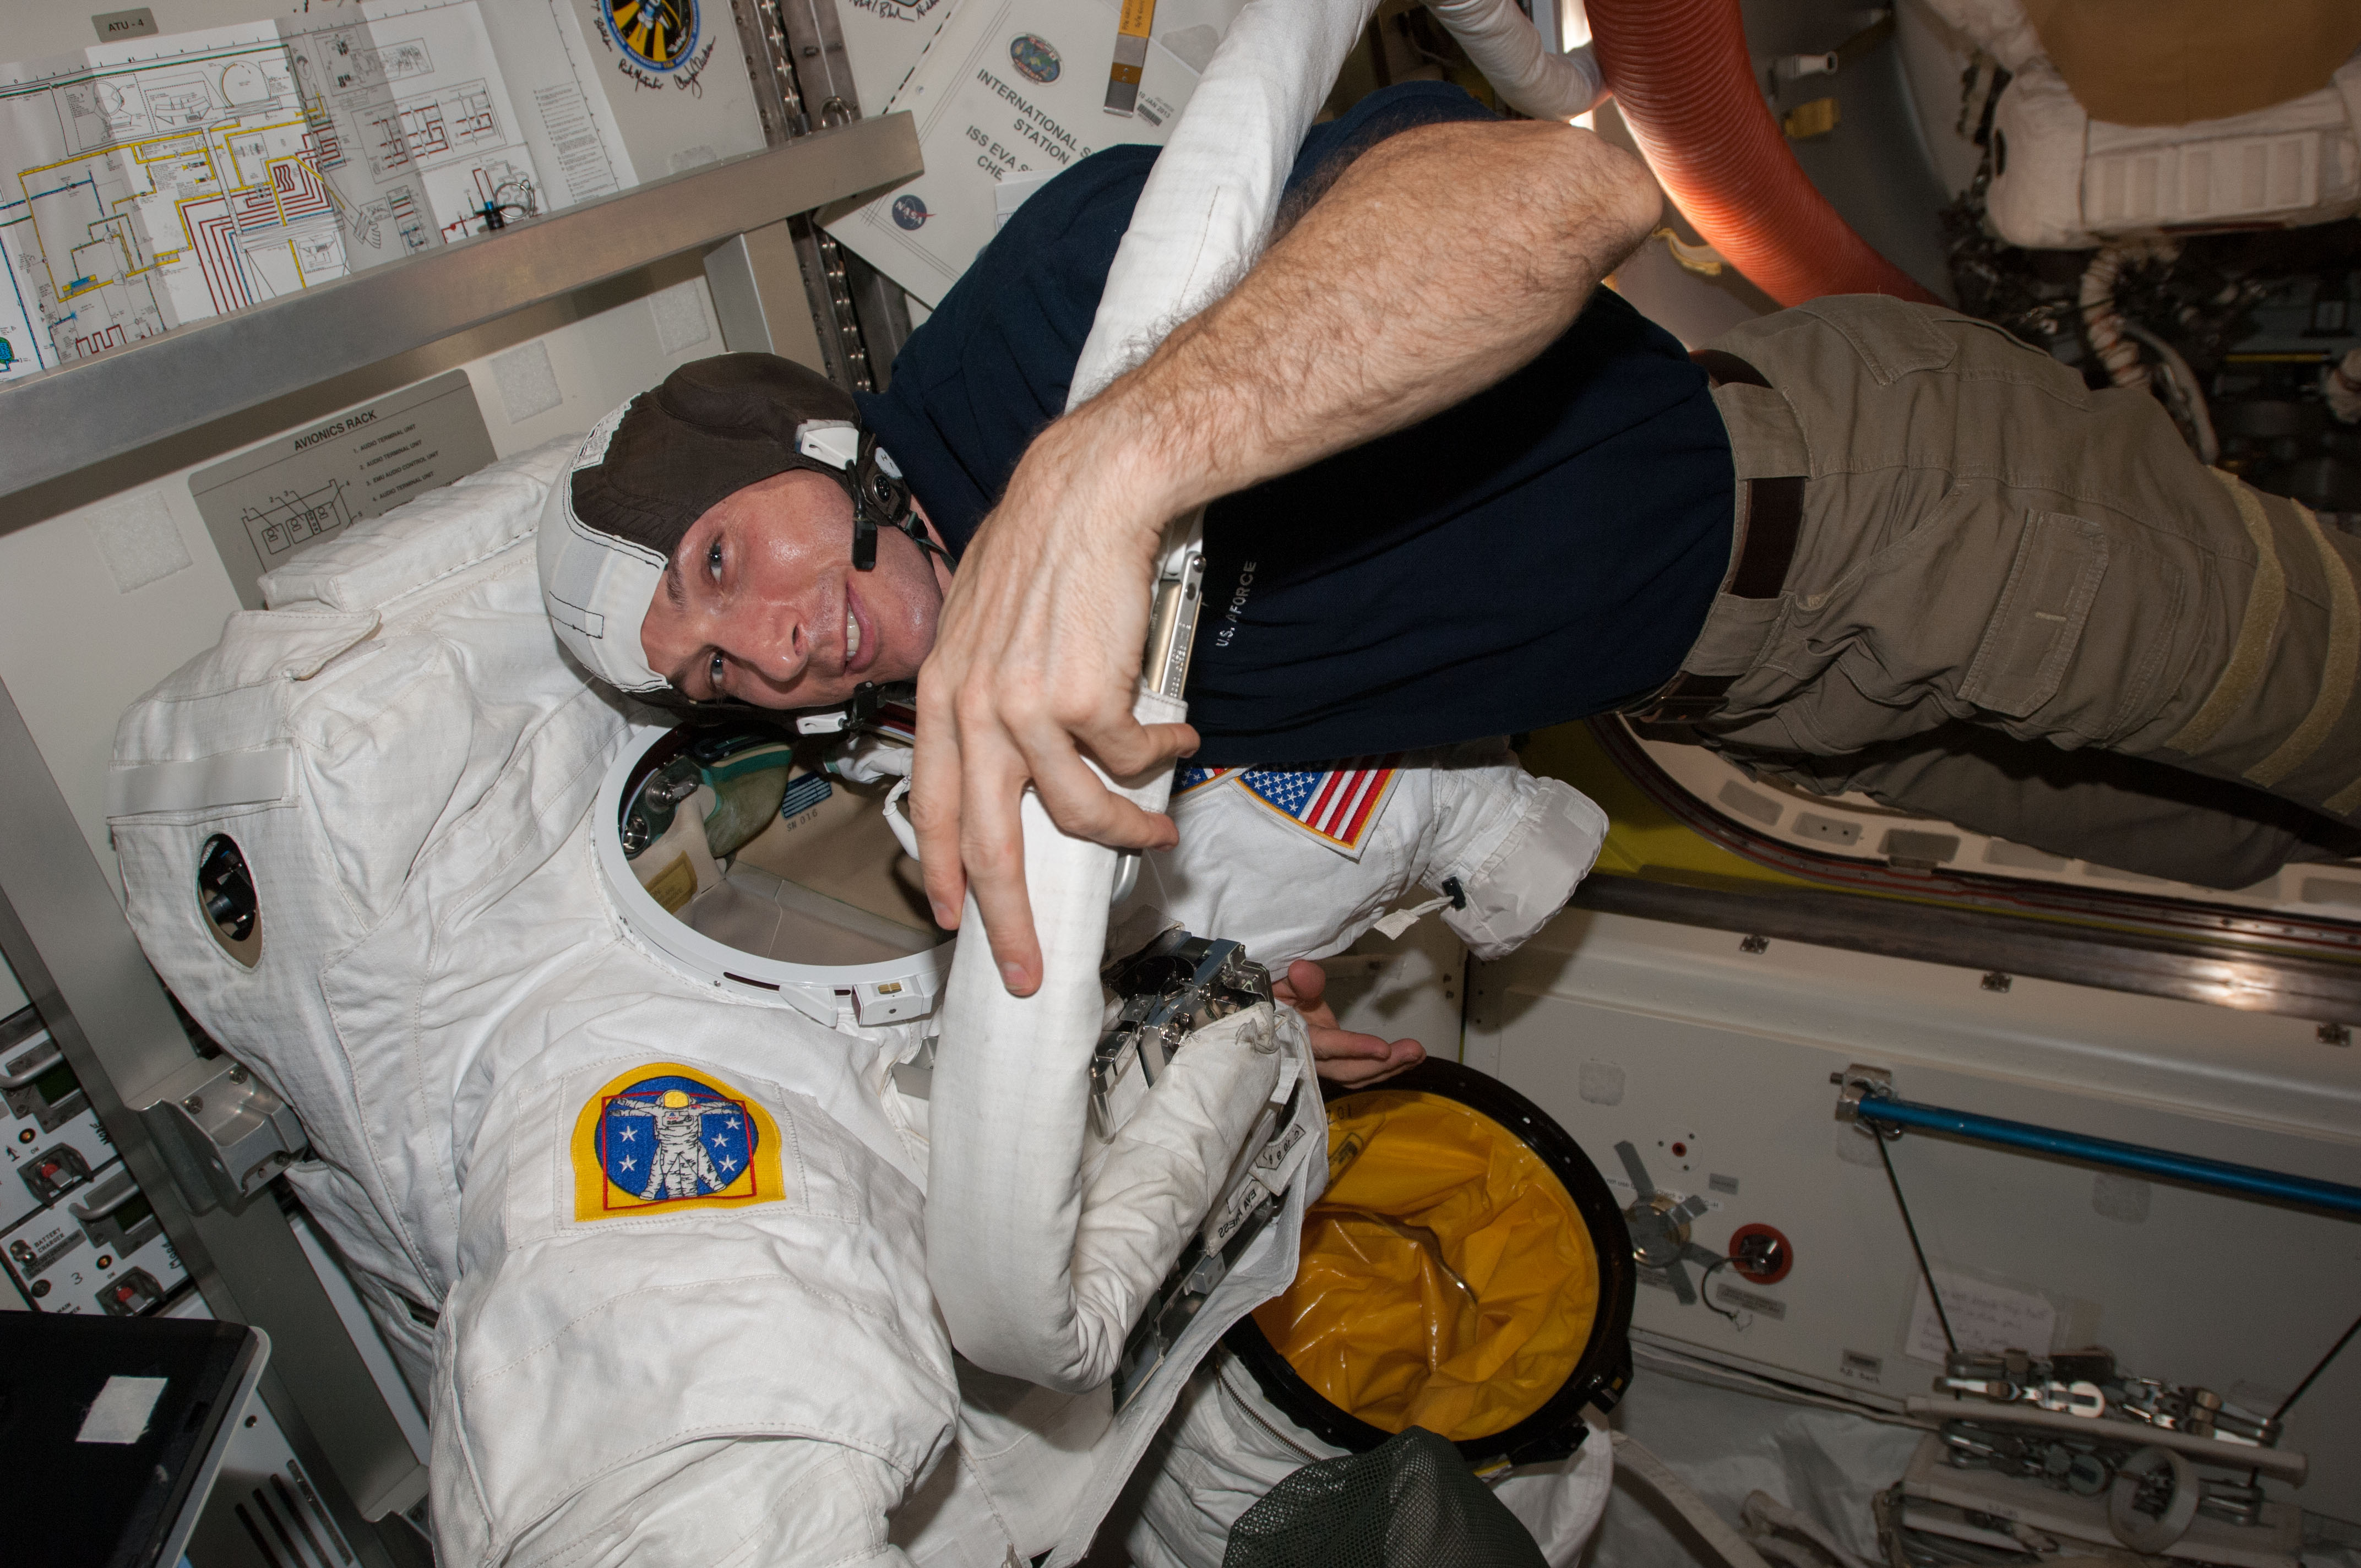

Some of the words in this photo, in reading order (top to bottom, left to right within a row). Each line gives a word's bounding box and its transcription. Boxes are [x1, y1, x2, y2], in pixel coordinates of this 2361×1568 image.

[108, 21, 129, 31] ATU
[138, 19, 144, 27] 4
[977, 68, 1077, 151] INTERNATIONAL
[1145, 97, 1157, 108] JAN
[1157, 106, 1171, 118] 2013
[966, 125, 989, 146] ISS
[989, 143, 1016, 168] EVA
[1014, 118, 1070, 165] STATION
[977, 156, 1006, 181] CHE
[293, 423, 345, 451] AVIONICS
[346, 409, 377, 430] RACK
[361, 440, 377, 451] AUDIO
[377, 429, 404, 443] TERMINAL
[404, 424, 416, 432] UNIT
[367, 456, 383, 467] AUDIO
[383, 445, 410, 460] TERMINAL
[410, 439, 422, 448] UNIT
[385, 467, 401, 477] AUDIO
[402, 456, 426, 470] CONTROL
[427, 450, 438, 459] UNIT
[379, 488, 396, 499] AUDIO
[396, 478, 422, 491] TERMINAL
[422, 471, 434, 480] UNIT
[1215, 627, 1235, 647] U.S.
[1229, 560, 1257, 614] FORCE
[788, 821, 796, 831] SN
[801, 809, 817, 824] 016
[35, 1226, 60, 1247] BATTERY
[39, 1233, 64, 1253] CHARGER
[72, 1272, 83, 1285] 3
